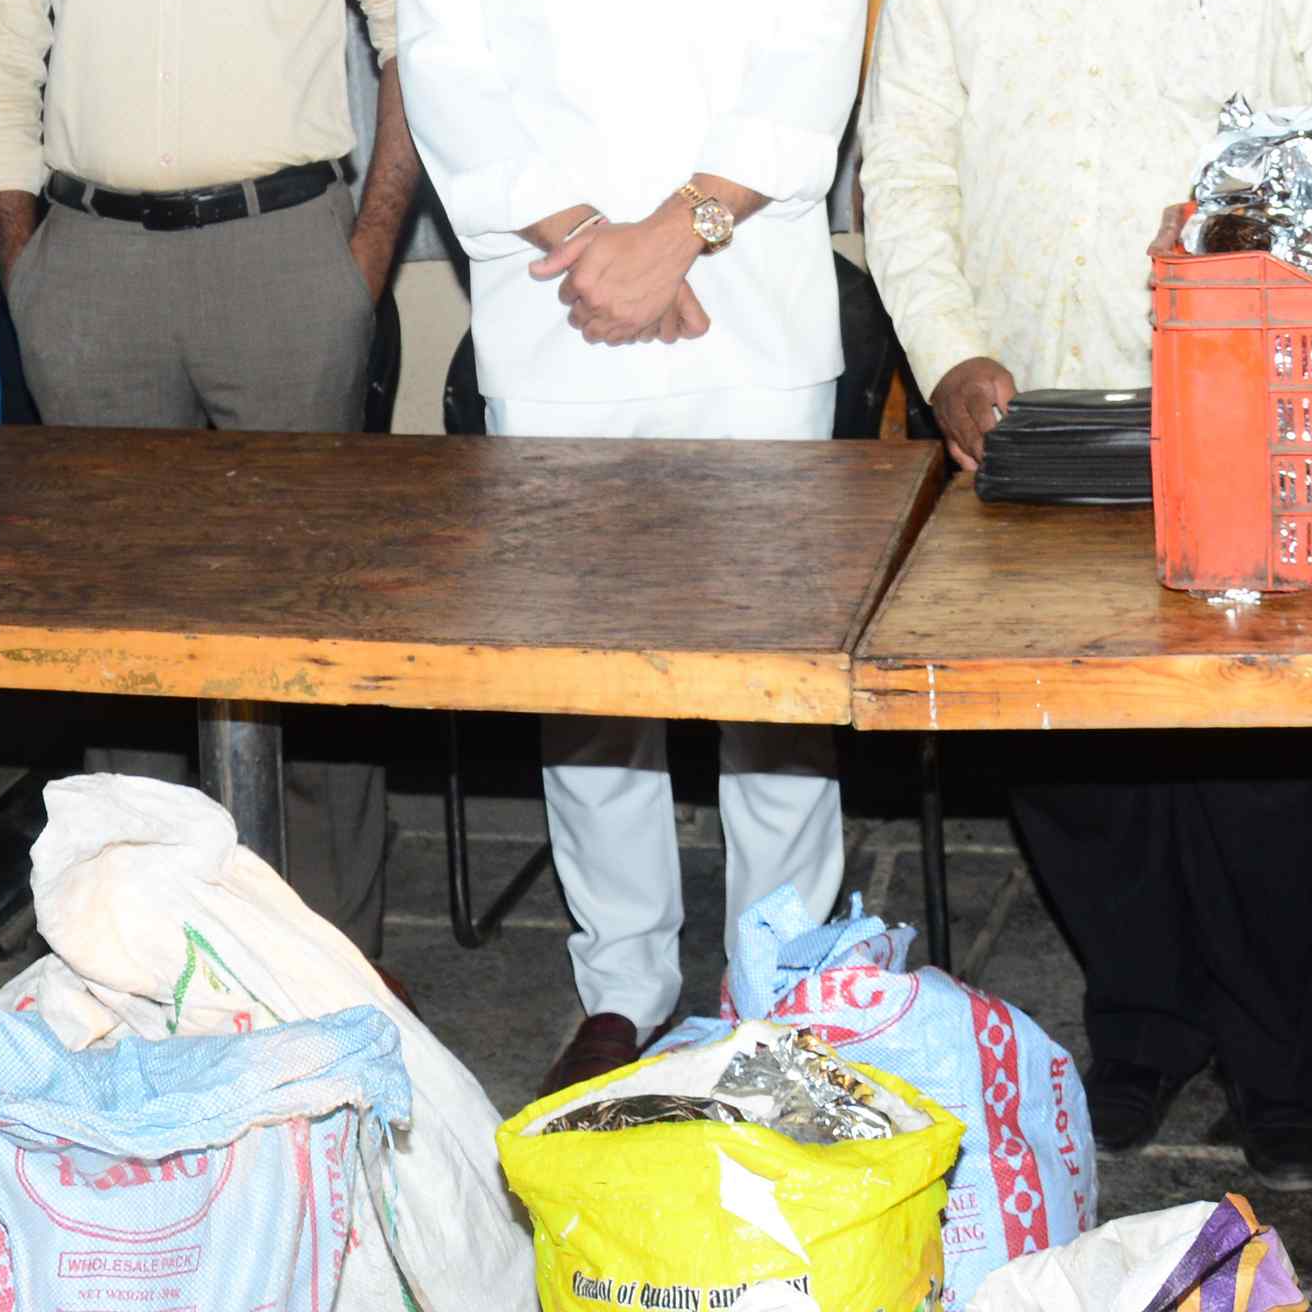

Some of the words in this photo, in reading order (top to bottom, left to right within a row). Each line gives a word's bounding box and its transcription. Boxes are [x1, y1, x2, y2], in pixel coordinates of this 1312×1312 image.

[1049, 1056, 1081, 1177] FLOUR
[68, 1258, 158, 1273] WHOLESALE
[160, 1254, 193, 1270] PACK
[616, 1281, 638, 1306] of
[640, 1282, 701, 1312] Quality
